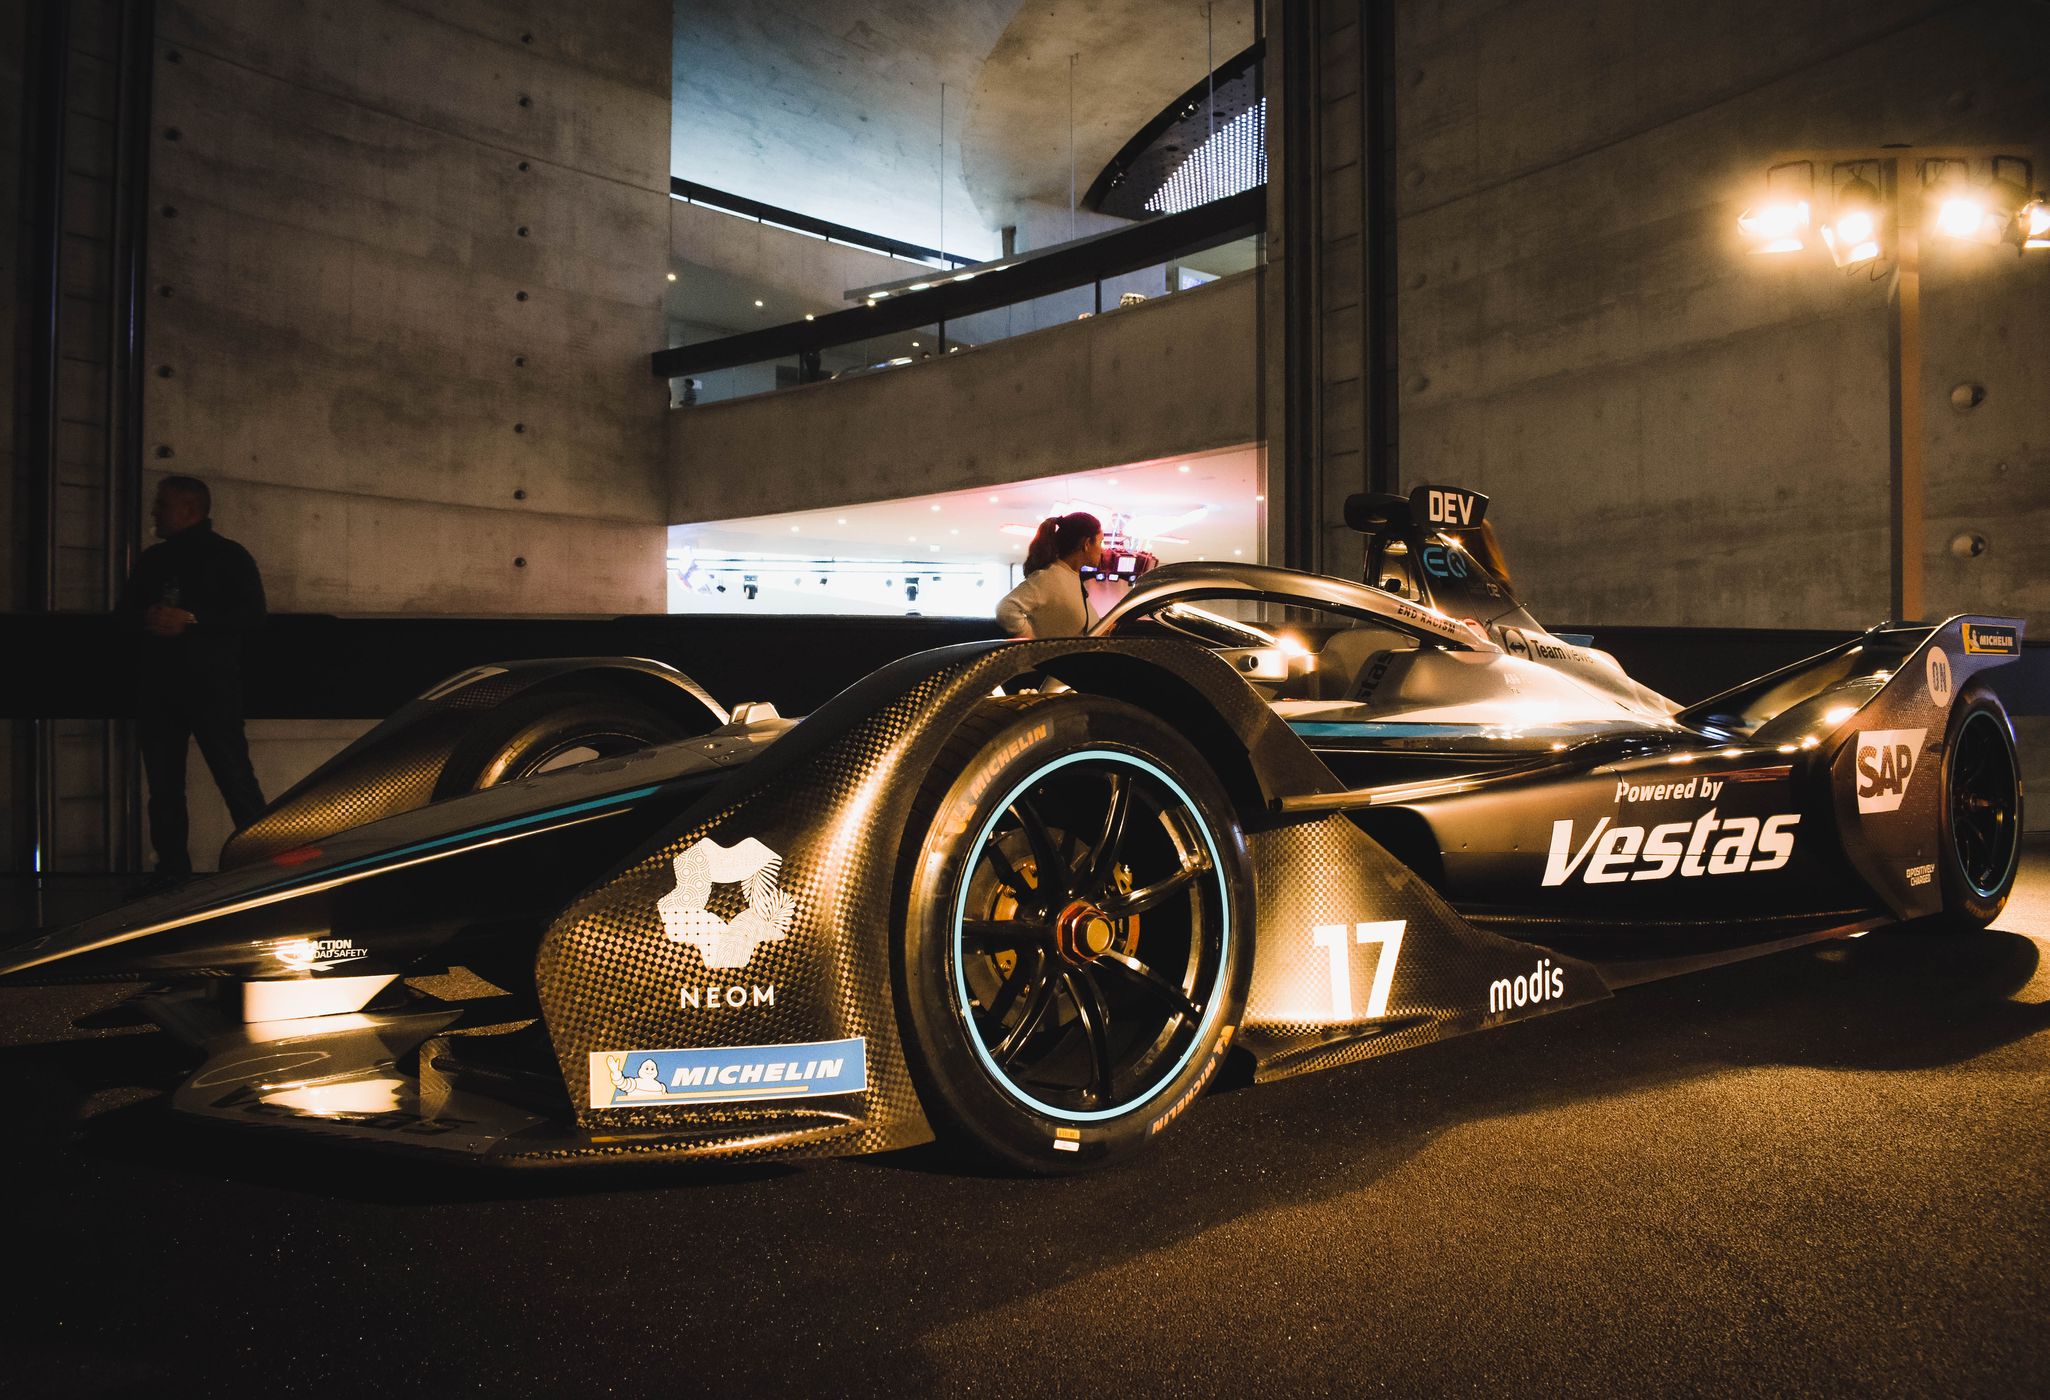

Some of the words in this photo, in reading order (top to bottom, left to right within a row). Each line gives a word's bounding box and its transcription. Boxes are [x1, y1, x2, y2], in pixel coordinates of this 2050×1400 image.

[1429, 490, 1474, 526] DEV
[1397, 605, 1417, 619] END
[1420, 613, 1456, 634] RACISM
[1979, 635, 2013, 647] MICHELIN
[970, 723, 1047, 800] MICHELIN
[1857, 744, 1912, 799] SAP
[1614, 778, 1697, 803] Powered
[1700, 777, 1723, 801] by
[1541, 807, 1802, 886] Vestas
[310, 949, 333, 959] OAD
[334, 948, 368, 958] SAFETY
[1312, 919, 1407, 1020] 17
[680, 985, 775, 1009] NEOM
[1490, 958, 1565, 1014] modis
[670, 1058, 845, 1087] MICHELIN
[1151, 1056, 1217, 1135] MICHELIN
